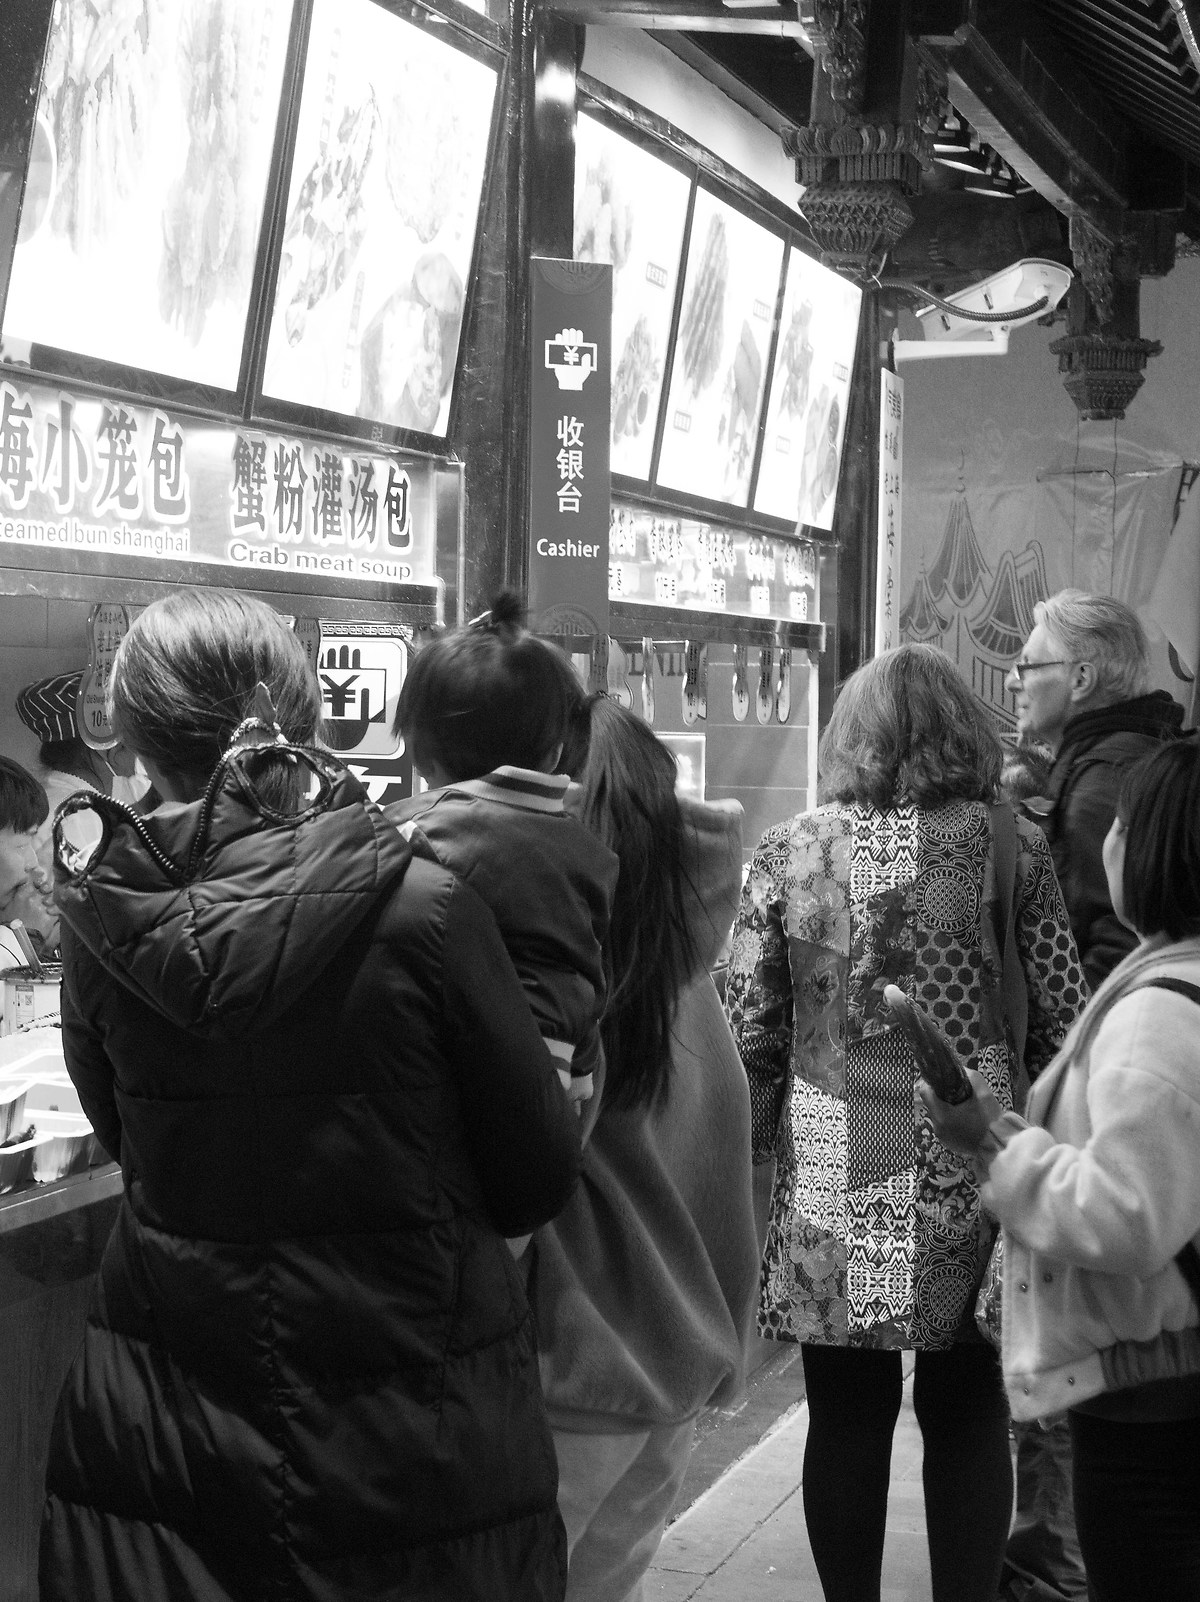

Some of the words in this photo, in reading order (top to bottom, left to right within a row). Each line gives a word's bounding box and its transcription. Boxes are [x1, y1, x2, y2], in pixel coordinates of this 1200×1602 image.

[556, 415, 584, 513] 收银台
[233, 434, 410, 548] 蟹粉灌汤包
[74, 523, 108, 544] bun
[113, 525, 189, 555] shanghai
[536, 538, 600, 558] Cashier
[230, 543, 289, 565] Crab
[296, 554, 353, 572] meat
[361, 560, 411, 581] soup
